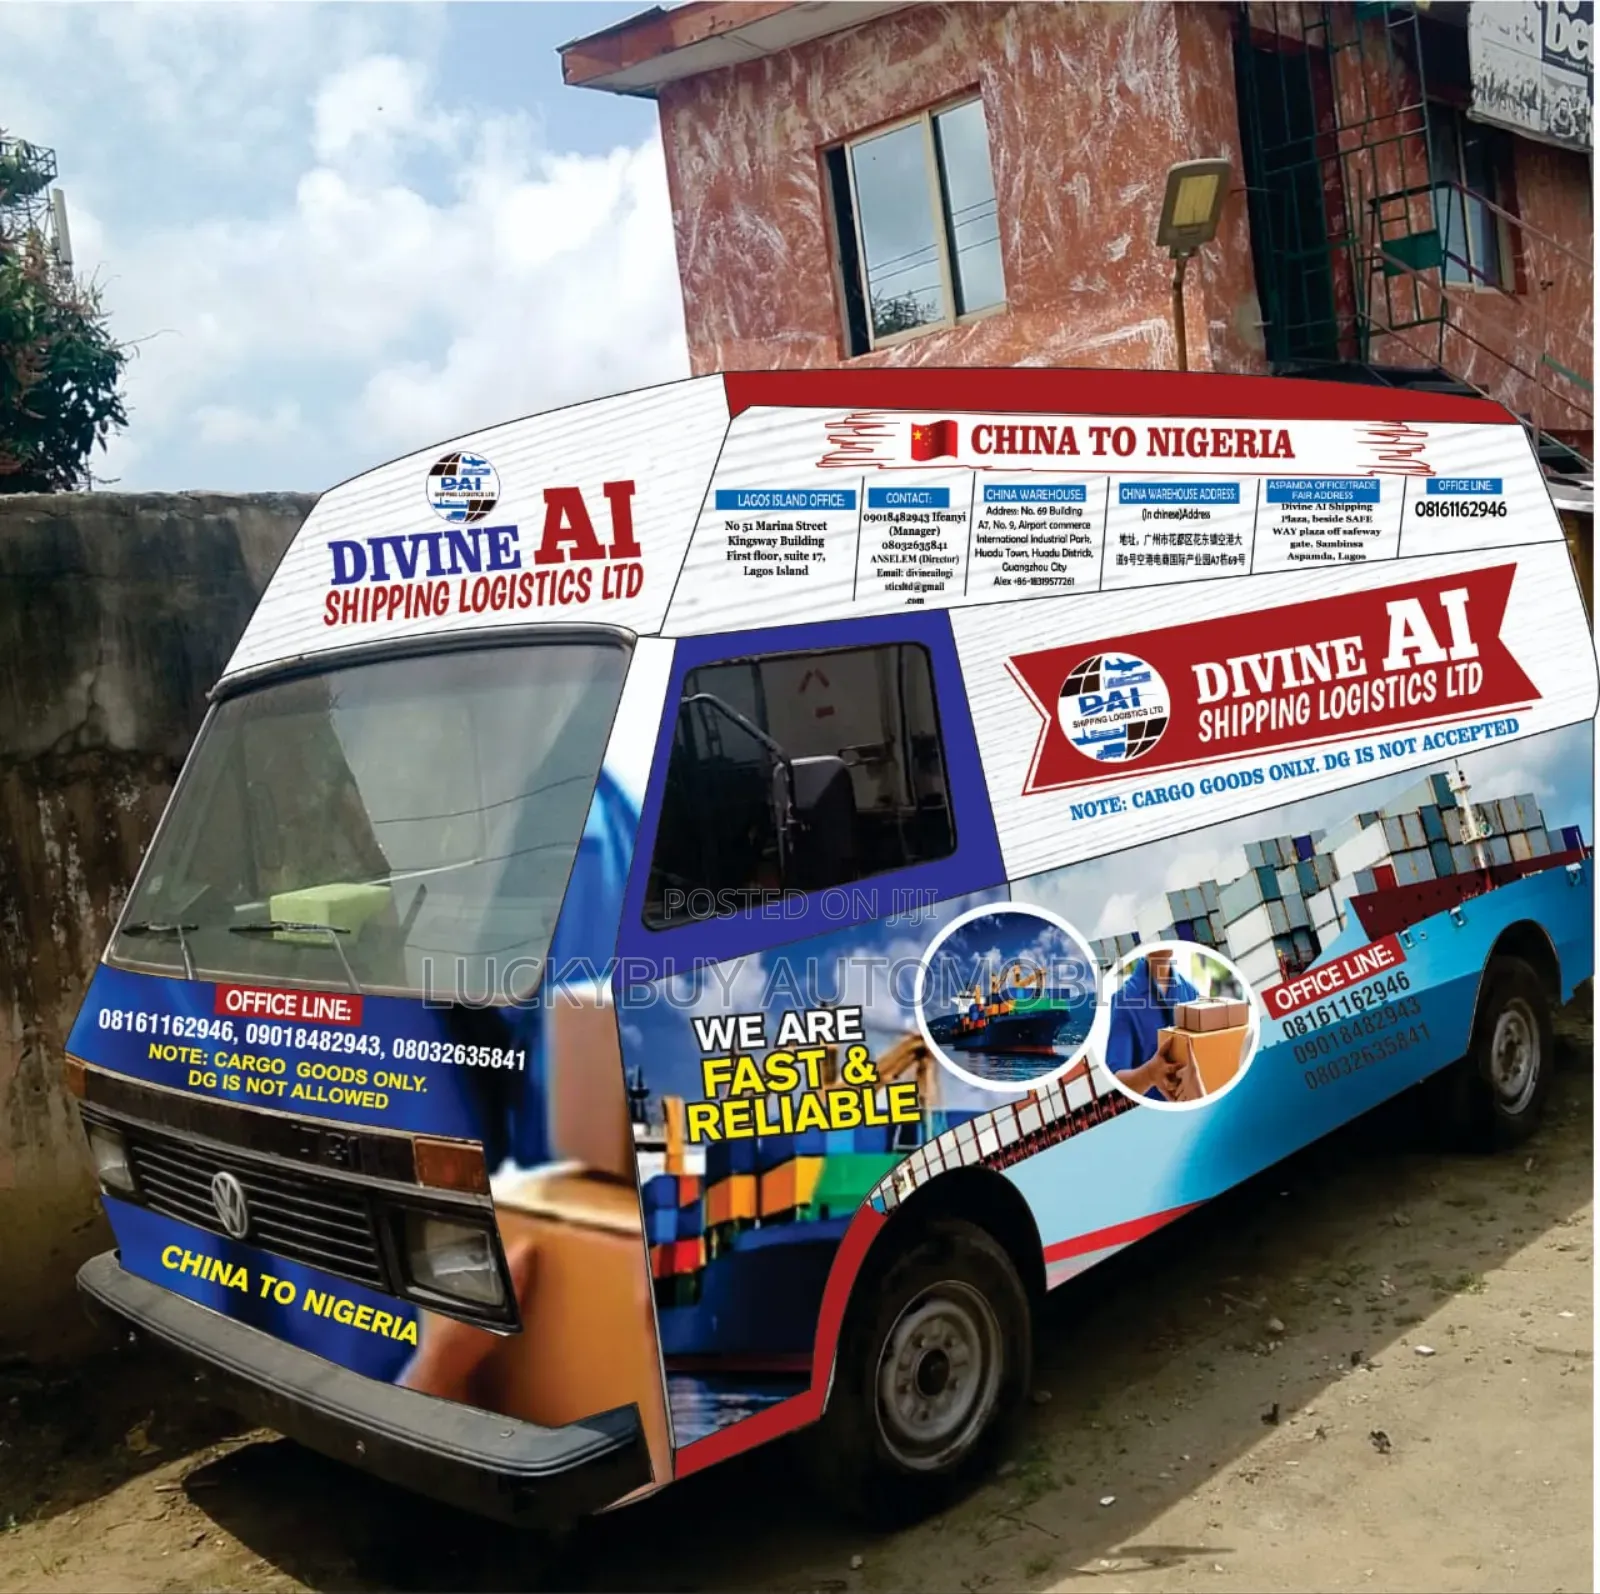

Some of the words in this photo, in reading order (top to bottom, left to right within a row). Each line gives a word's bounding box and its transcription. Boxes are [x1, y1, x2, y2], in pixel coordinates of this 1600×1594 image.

[971, 424, 1080, 455] CHINA
[1089, 426, 1136, 456] TO
[1147, 427, 1295, 459] NIGERIA
[441, 477, 481, 490] DAI
[1269, 481, 1313, 489] ASPAMDA
[1315, 481, 1377, 489] OFFICE/TRADE
[1438, 480, 1469, 491] OFFICE
[1470, 480, 1493, 491] LINE:
[738, 494, 770, 506] LAGOS
[772, 494, 807, 506] ISLAND
[809, 494, 845, 507] OFFICE:
[886, 493, 932, 503] CONTACT:
[986, 489, 1017, 500] CHINA
[1020, 489, 1083, 500] WAREHOUSE:
[1121, 488, 1147, 500] CHINA
[1149, 488, 1198, 500] WAREHOUSE
[1292, 491, 1312, 499] FAIR
[1314, 491, 1353, 499] ADDRESS
[986, 506, 1019, 516] Address:
[1021, 506, 1035, 516] No.
[1037, 506, 1047, 516] 69
[1049, 506, 1083, 517] Building
[1281, 503, 1313, 511] Divine
[1315, 503, 1326, 511] AI
[1329, 503, 1373, 512] Shipping
[1415, 501, 1507, 517] 08161162946
[863, 512, 930, 523] 09018482943
[932, 512, 966, 524] Ifeanyi
[1142, 508, 1152, 521] (In
[1281, 515, 1310, 524] Plaza,
[1312, 515, 1344, 523] beside
[1346, 515, 1373, 523] SAFE
[725, 521, 740, 530] No
[742, 523, 753, 532] 51
[756, 521, 794, 531] Marina
[796, 521, 827, 531] Street
[889, 526, 940, 538] (Manager)
[978, 520, 991, 530] A7,
[993, 520, 1007, 529] No.
[1009, 521, 1016, 530] 9,
[1019, 520, 1047, 531] Airport
[1049, 522, 1091, 530] commerce
[1272, 527, 1297, 535] WAY
[1299, 527, 1325, 536] plaza
[1327, 527, 1342, 535] off
[1342, 527, 1382, 537] safeway
[328, 525, 521, 585] DIVINE
[534, 480, 641, 565] AI
[976, 534, 1028, 543] International
[1030, 534, 1067, 543] Industrial
[728, 535, 778, 548] Kingsway
[780, 535, 825, 548] Building
[882, 540, 948, 551] 08032635841
[1290, 541, 1313, 549] gate,
[1316, 540, 1364, 548] Sambinsa
[726, 550, 751, 561] First
[754, 550, 782, 562] floor,
[784, 550, 809, 561] suite
[812, 552, 825, 562] 17,
[975, 548, 1003, 557] Huadu
[1032, 548, 1060, 557] Huadu
[1287, 552, 1335, 562] Aspamda,
[1338, 552, 1366, 561] Lagos
[870, 554, 917, 563] ANSELEM
[919, 554, 959, 565] (Director)
[744, 565, 774, 578] Lagos
[776, 565, 809, 576] Island
[876, 568, 904, 577] Email:
[1002, 562, 1048, 573] Guangzhou
[1051, 562, 1067, 572] City
[884, 582, 945, 592] sticsltd@gmail
[994, 576, 1011, 586] Alex
[324, 581, 449, 626] SHIPPING
[459, 567, 592, 613] LOGISTICS
[602, 563, 644, 600] LTD
[1191, 636, 1366, 704] DIVINE
[1382, 587, 1480, 671] AI
[1078, 687, 1140, 716] DAI
[1199, 692, 1311, 743] SHIPPING
[1318, 670, 1437, 720] LOGISTICS
[1446, 662, 1483, 697] LTD
[1072, 715, 1107, 728] SHIPPING
[1109, 708, 1148, 722] LOGISTICS
[1149, 706, 1163, 715] LTD
[1070, 794, 1127, 821] NOTE:
[1131, 780, 1195, 807] CARGO
[1199, 767, 1265, 796] GOODS
[1268, 757, 1320, 783] ONLY.
[1323, 749, 1351, 770] DG
[1355, 746, 1374, 764] IS
[1377, 737, 1418, 761] NOT
[1421, 717, 1519, 752] ACCEPTED
[1275, 970, 1344, 1010] OFFICE
[1345, 949, 1396, 980] LINE:
[226, 989, 296, 1018] OFFICE
[301, 994, 352, 1020] LINE:
[1282, 971, 1411, 1041] 08161162946
[691, 1014, 764, 1051] WE
[777, 1005, 864, 1045] ARE
[1293, 996, 1421, 1065] 09018482943
[98, 1009, 239, 1045] 08161162946,
[245, 1024, 386, 1060] 09018482943,
[393, 1038, 526, 1071] 08032635841
[1304, 1022, 1432, 1090] 08032635841
[148, 1043, 208, 1064] NOTE:
[213, 1051, 286, 1075] CARGO
[296, 1062, 368, 1085] GOODS
[373, 1070, 428, 1093] ONLY.
[702, 1049, 824, 1098] FAST
[843, 1049, 879, 1085] &
[188, 1070, 217, 1088] DG
[222, 1074, 241, 1091] IS
[246, 1077, 286, 1097] NOT
[291, 1083, 388, 1110] ALLOWED
[685, 1083, 922, 1145] RELIABLE
[161, 1244, 249, 1292] CHINA
[259, 1275, 297, 1305] TO
[302, 1290, 418, 1346] NIGERIA
